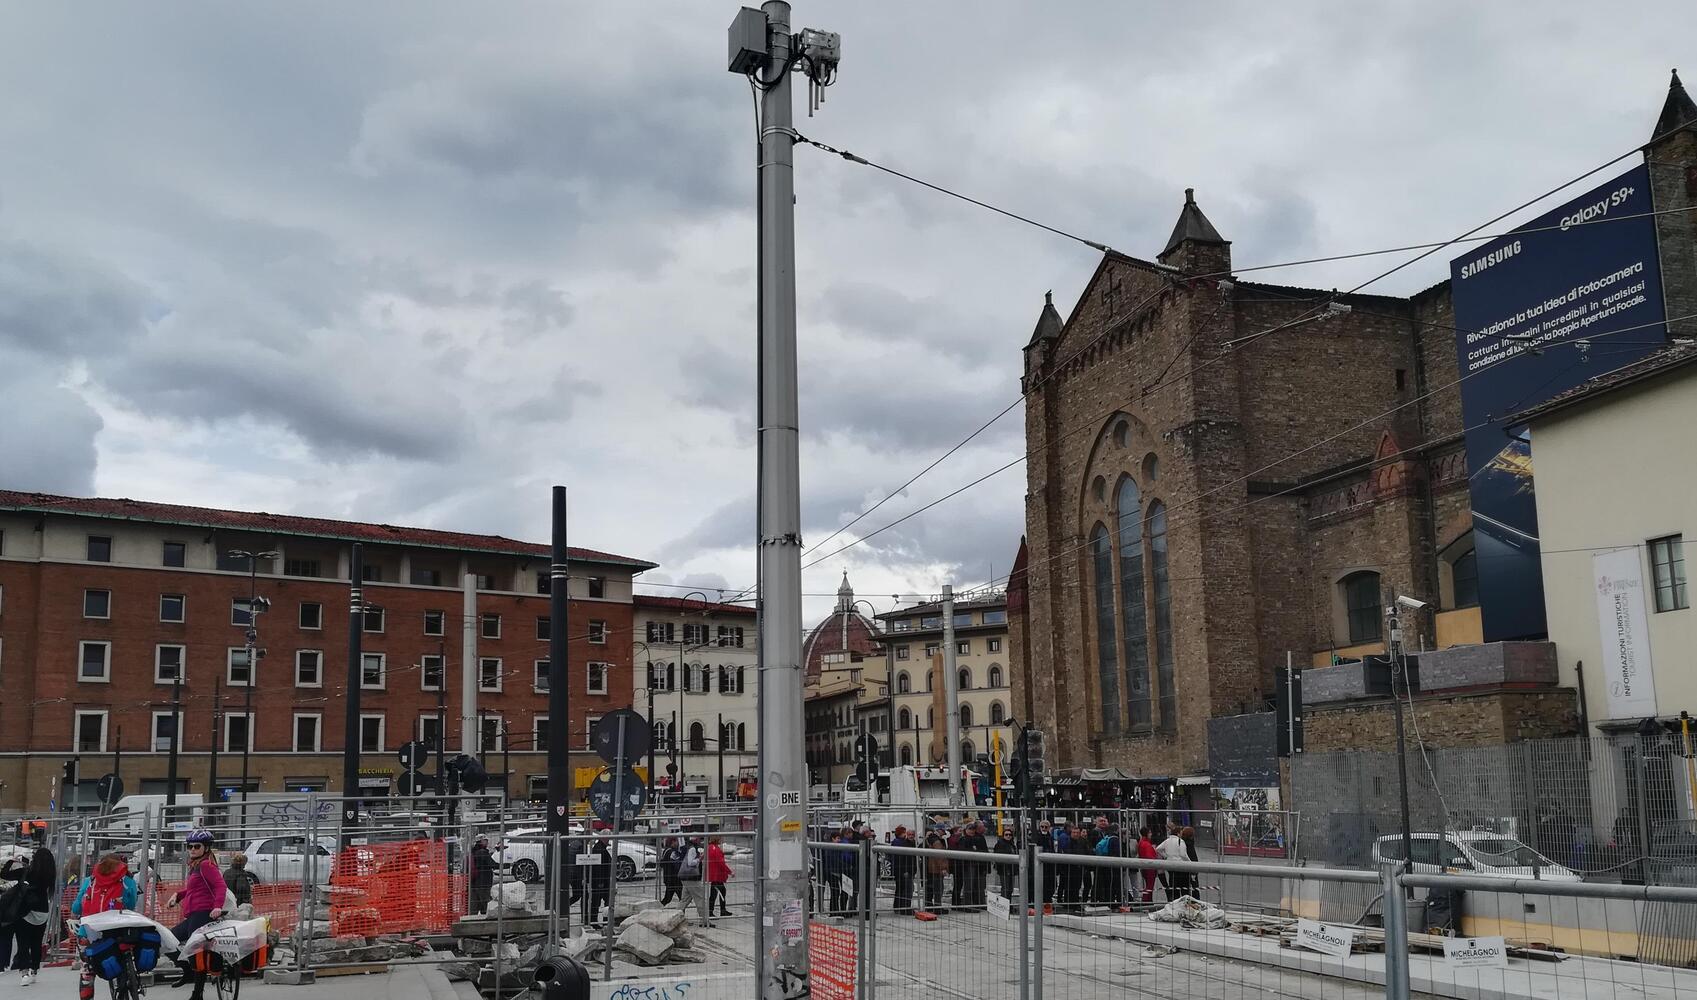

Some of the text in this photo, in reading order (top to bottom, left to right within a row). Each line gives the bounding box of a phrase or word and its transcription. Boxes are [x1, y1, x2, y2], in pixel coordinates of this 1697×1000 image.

[1559, 186, 1635, 231] Galaxy S9+
[1461, 240, 1522, 279] SAMSUNG
[1466, 261, 1643, 344] Rivoluziona la tua idea di Fotocamera
[1468, 342, 1499, 360] Cattura
[1543, 304, 1588, 330] incredibili
[1590, 301, 1599, 311] in
[1602, 280, 1645, 307] qualsiasi
[1469, 350, 1506, 371] condizione
[1544, 332, 1552, 341] la
[1552, 321, 1580, 338] Doppia
[1580, 306, 1616, 327] Apertura
[1616, 294, 1647, 312] Focale.
[1614, 593, 1631, 697] INFORMAZIONI TURISTICHE
[781, 792, 799, 804] BNE
[1302, 928, 1346, 946] MICHELAGNOLI
[1450, 948, 1499, 958] MICHELAGNOLI
